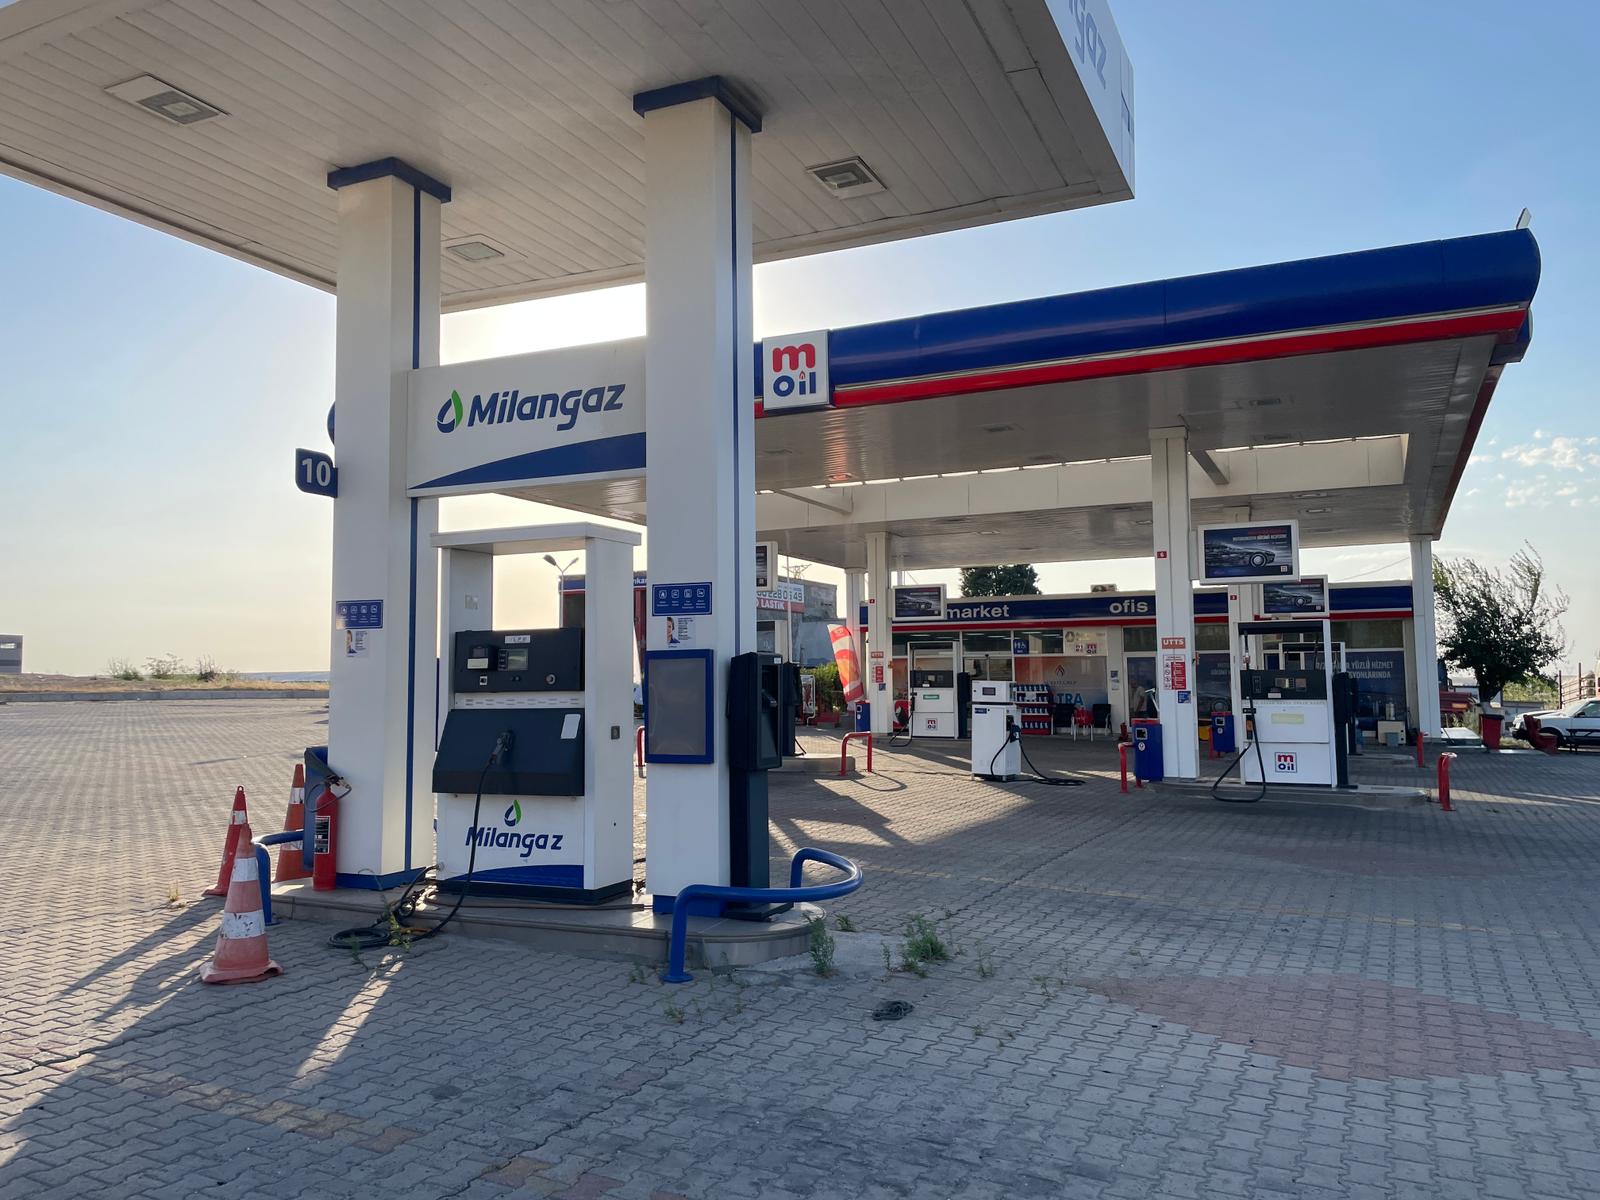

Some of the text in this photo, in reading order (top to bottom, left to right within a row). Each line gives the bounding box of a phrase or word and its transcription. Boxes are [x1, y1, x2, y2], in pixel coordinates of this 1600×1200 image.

[1068, 0, 1107, 91] gaz
[772, 343, 815, 373] m
[773, 371, 816, 397] oil
[467, 384, 626, 431] Milangaz
[302, 458, 331, 487] 10
[946, 603, 1010, 619] market
[1109, 599, 1149, 614] ofis
[1162, 638, 1185, 646] UTTS
[1348, 671, 1391, 679] SYONLARINDA
[1056, 692, 1084, 705] TRA
[465, 826, 563, 858] Milangaz
